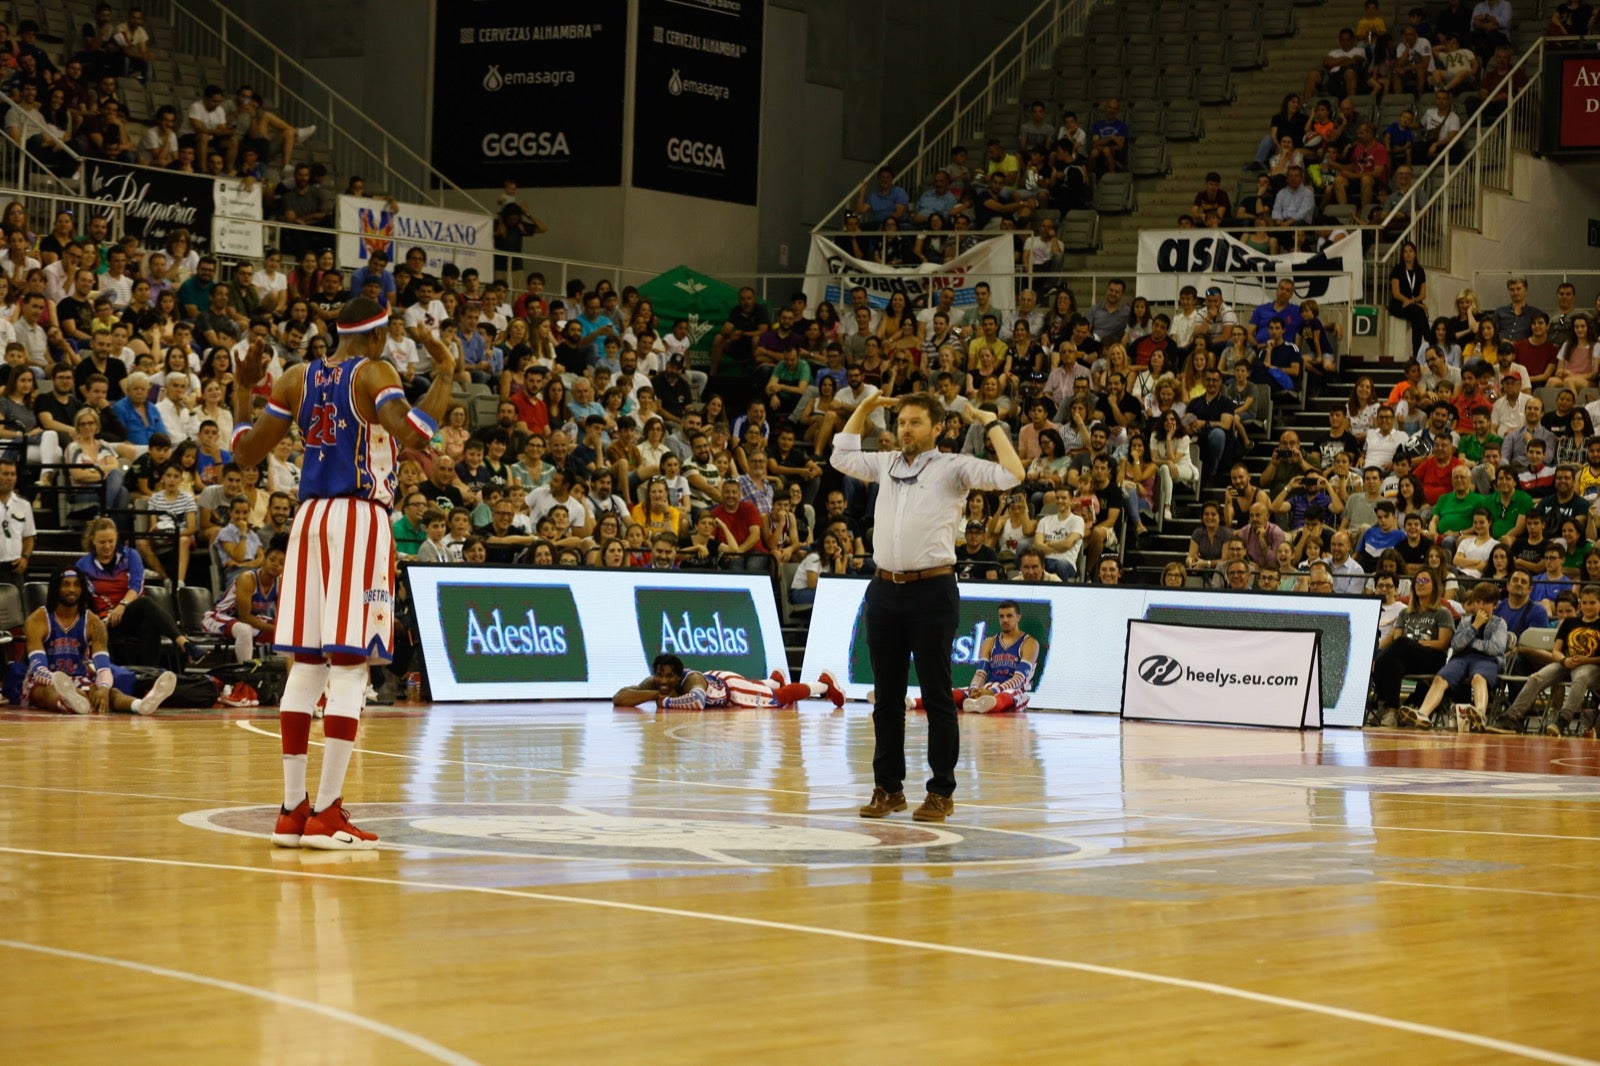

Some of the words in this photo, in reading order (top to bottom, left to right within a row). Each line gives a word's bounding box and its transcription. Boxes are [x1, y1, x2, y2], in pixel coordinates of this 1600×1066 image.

[478, 26, 531, 43] CERVEZAS
[532, 23, 593, 41] ALHAMBRA
[666, 29, 701, 50] CERVEZAS
[504, 70, 576, 87] emasagra
[683, 80, 730, 101] emasagra
[397, 216, 477, 246] MANZANO
[1355, 315, 1371, 336] D
[466, 607, 568, 654] Adeslas
[661, 610, 749, 655] Adeslas
[1186, 665, 1299, 688] heelys.eu.com
